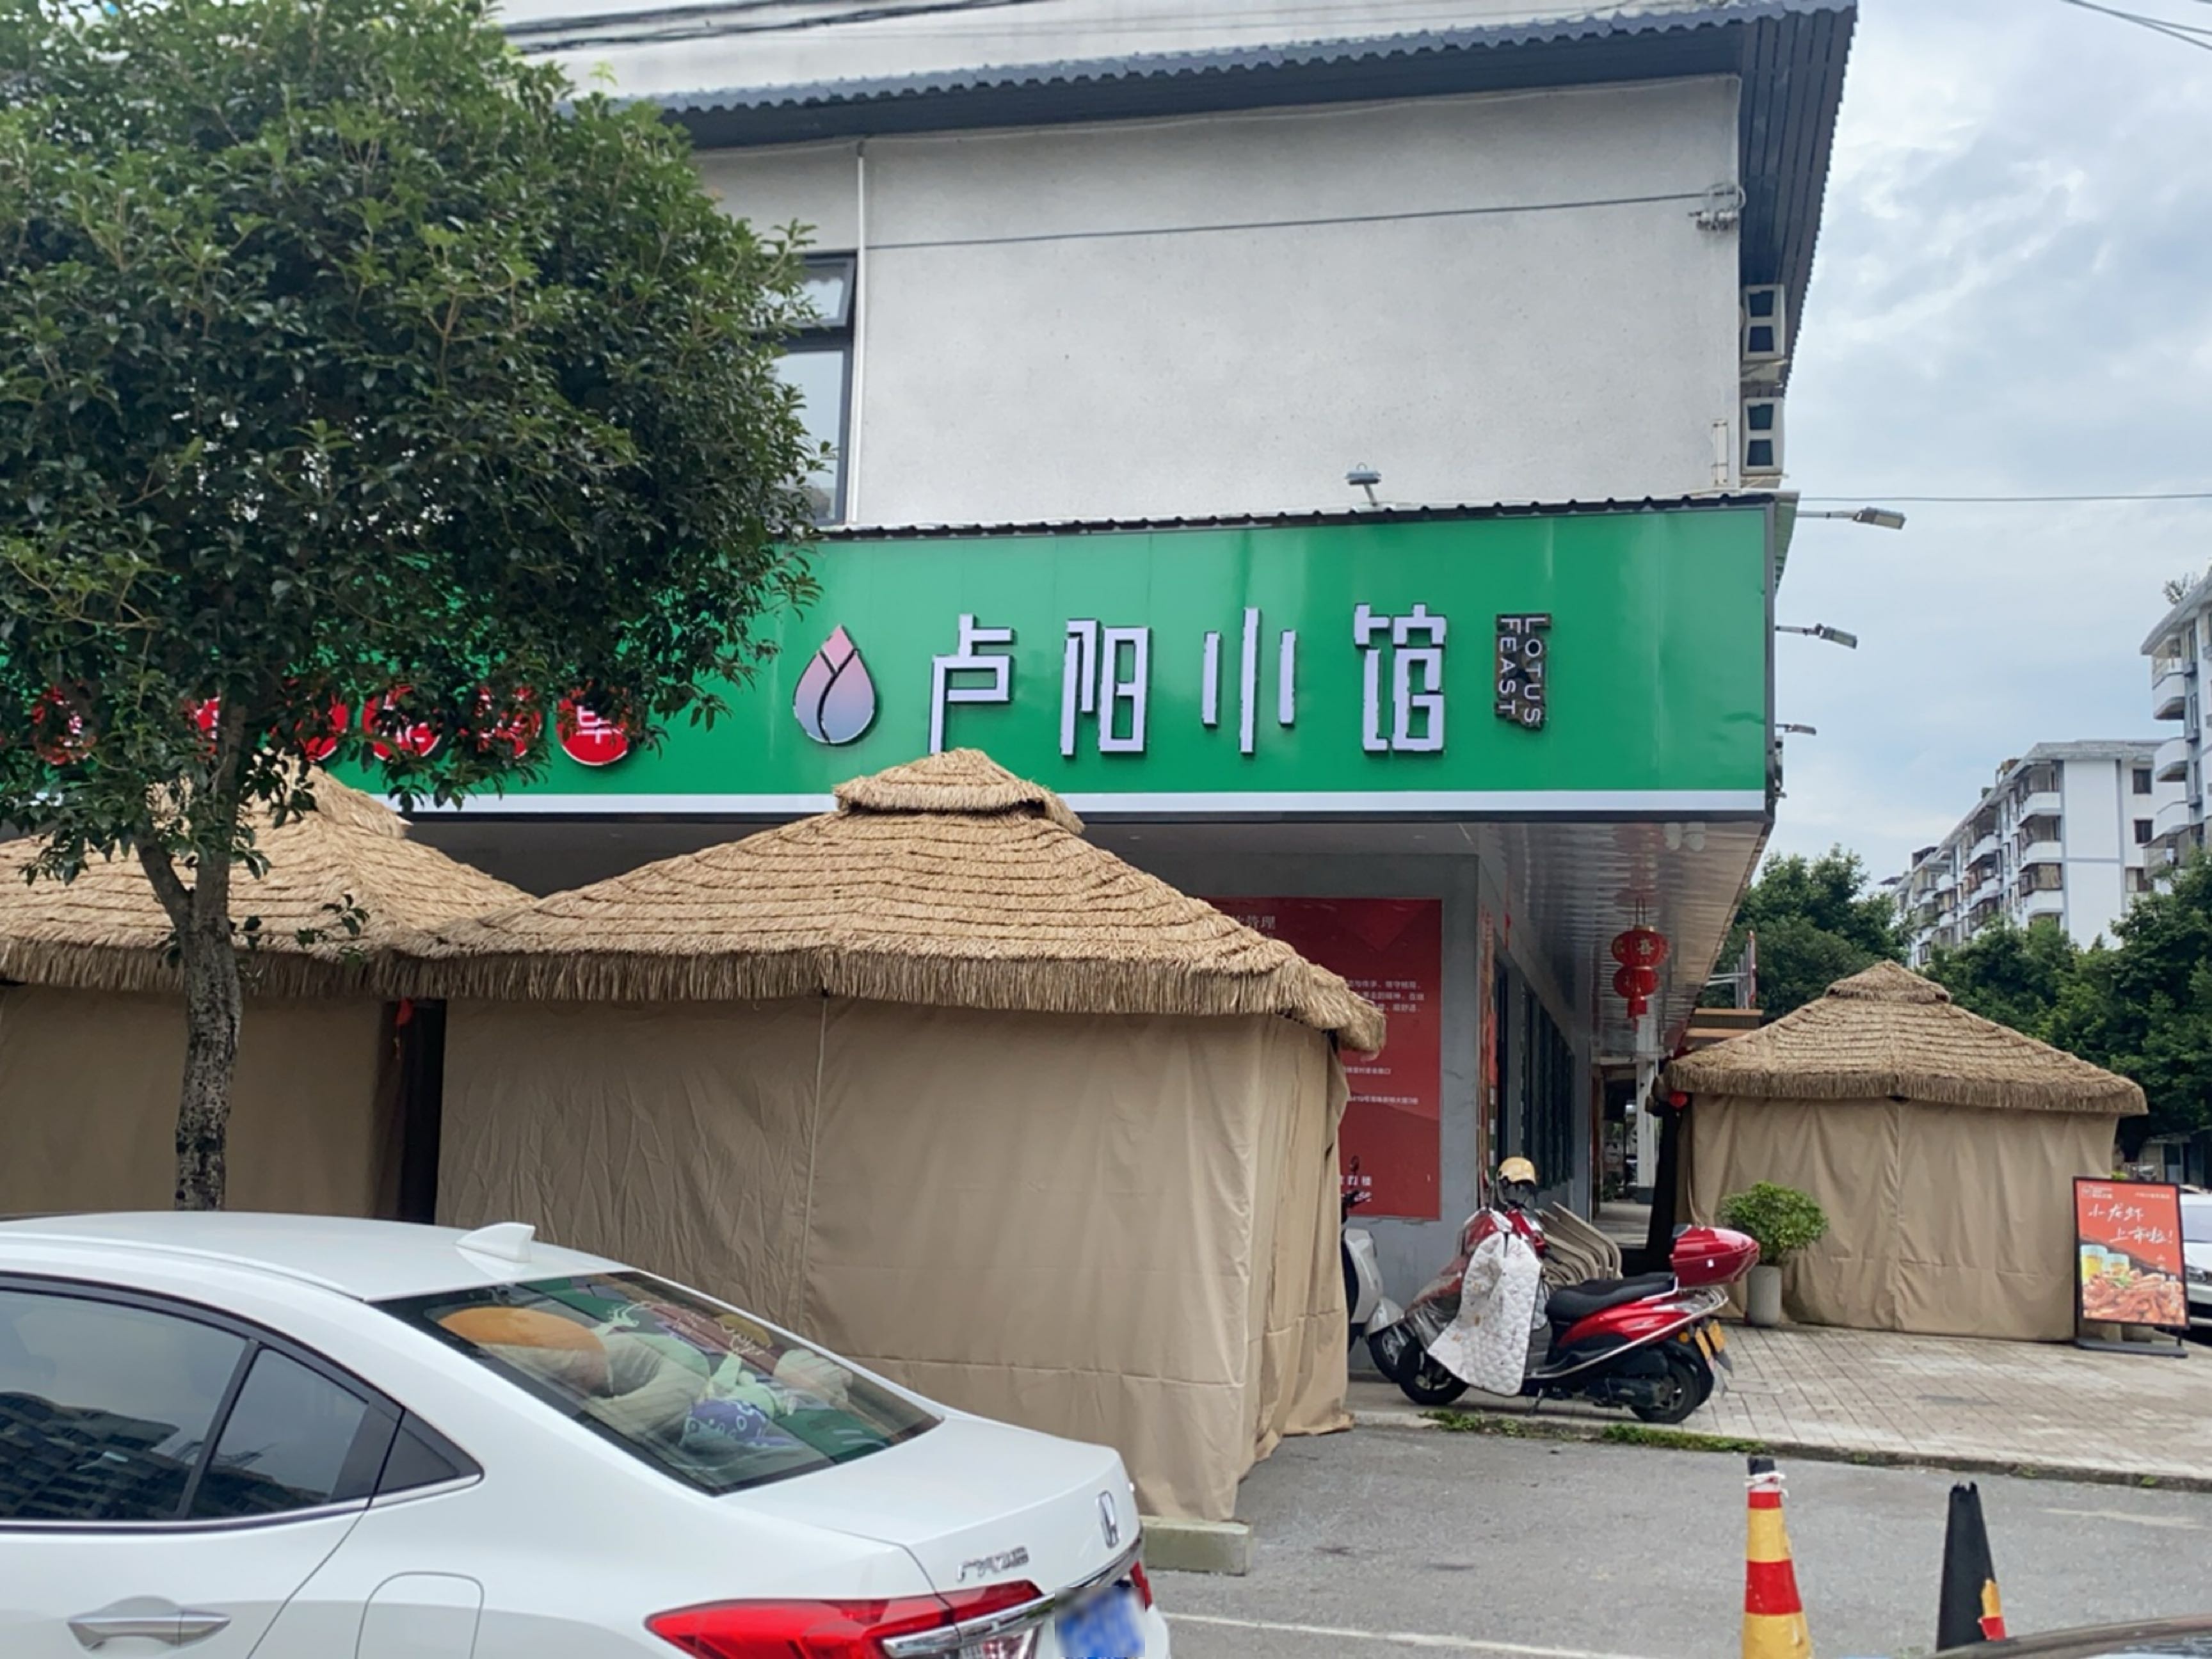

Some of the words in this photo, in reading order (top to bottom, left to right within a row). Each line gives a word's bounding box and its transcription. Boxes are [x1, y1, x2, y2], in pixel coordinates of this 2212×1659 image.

[929, 603, 1445, 756] 卢阳小馆
[1498, 617, 1521, 716] FEAST
[1524, 617, 1546, 723] LOTUS
[2088, 1203, 2144, 1222] 小龙虾
